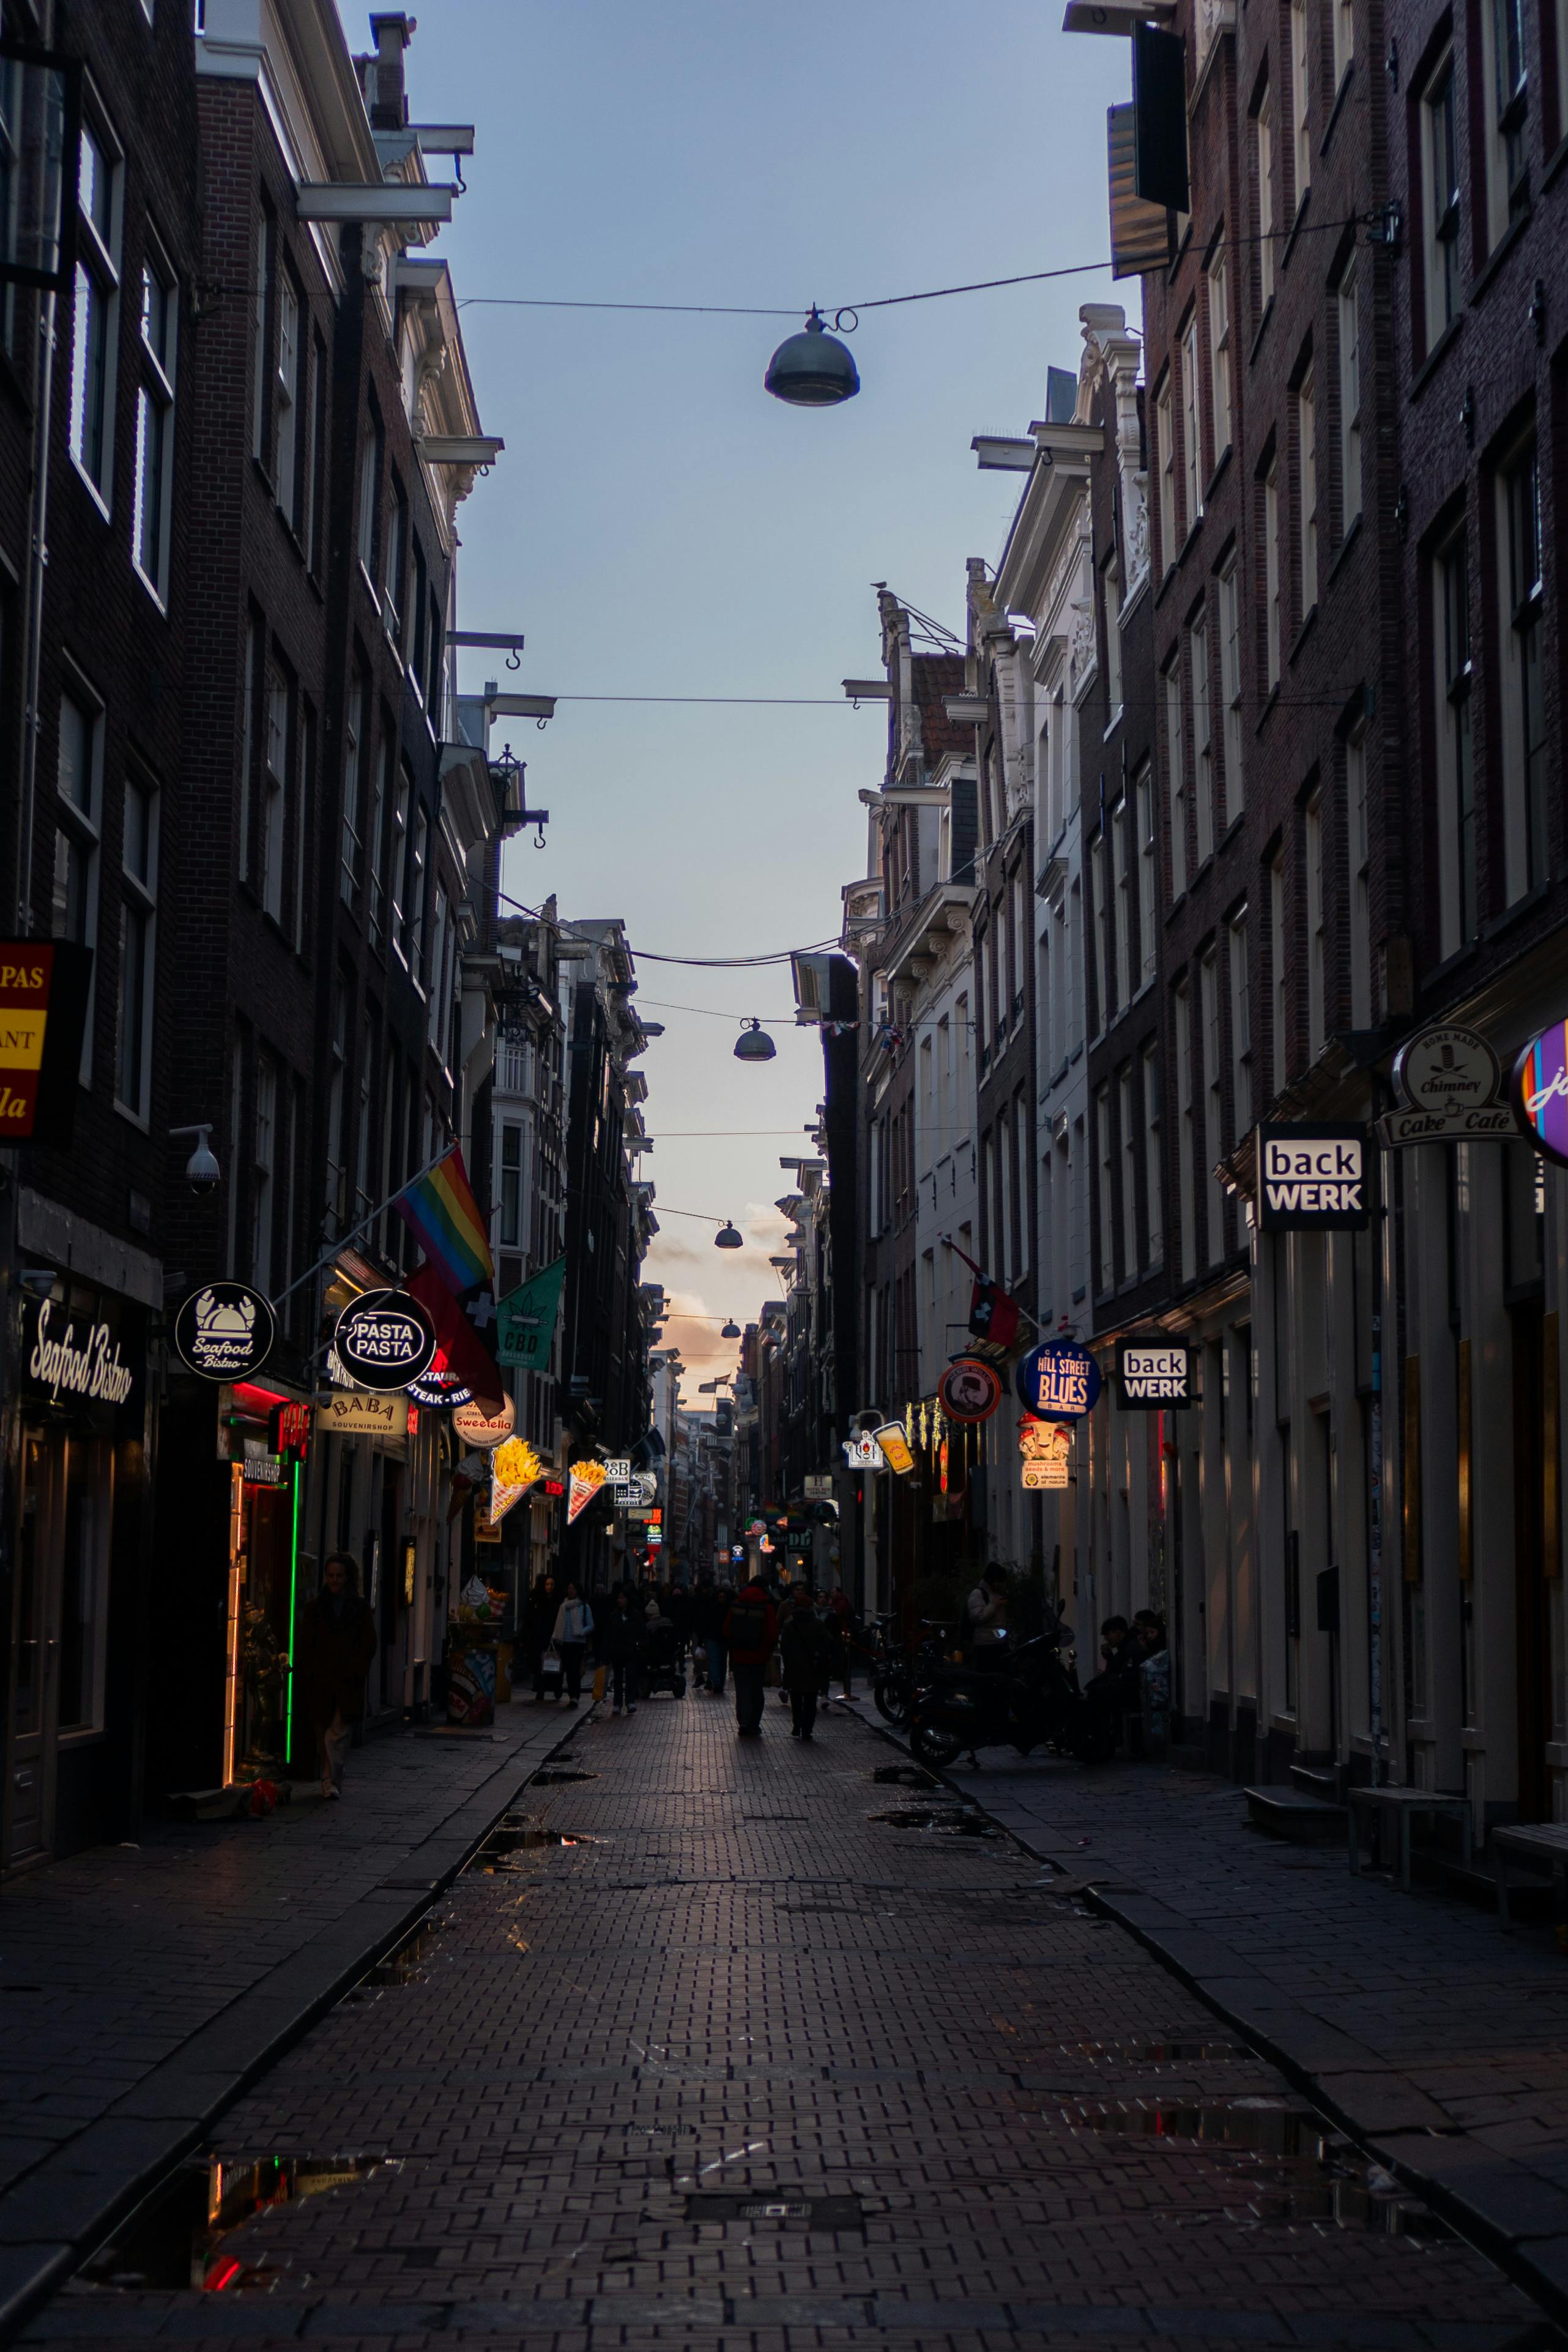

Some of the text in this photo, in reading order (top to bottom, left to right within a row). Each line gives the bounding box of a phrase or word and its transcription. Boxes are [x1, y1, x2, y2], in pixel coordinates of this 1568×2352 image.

[0, 1030, 35, 1049] NT
[1422, 1032, 1481, 1051] HOME MADE
[1421, 1079, 1482, 1094] Chimney
[1399, 1111, 1510, 1137] Cake Café
[1271, 1144, 1356, 1175] back
[1266, 1184, 1362, 1211] WERK
[357, 1323, 414, 1341] PASTA
[504, 1331, 538, 1353] CBD
[29, 1298, 133, 1405] Seafood Bistro
[192, 1336, 255, 1356] Seafood
[356, 1340, 413, 1357] PASTA
[1044, 1349, 1084, 1359] CAFE
[1037, 1356, 1091, 1377] HILL STREET
[1127, 1352, 1183, 1374] back
[1038, 1372, 1088, 1405] BLUES
[1124, 1379, 1187, 1398] WERK
[332, 1397, 394, 1421] BABA
[332, 1421, 393, 1431] SOUVENIRSHOP
[456, 1416, 511, 1430] Sweetella
[244, 1458, 280, 1483] SOUVENIRSHOP
